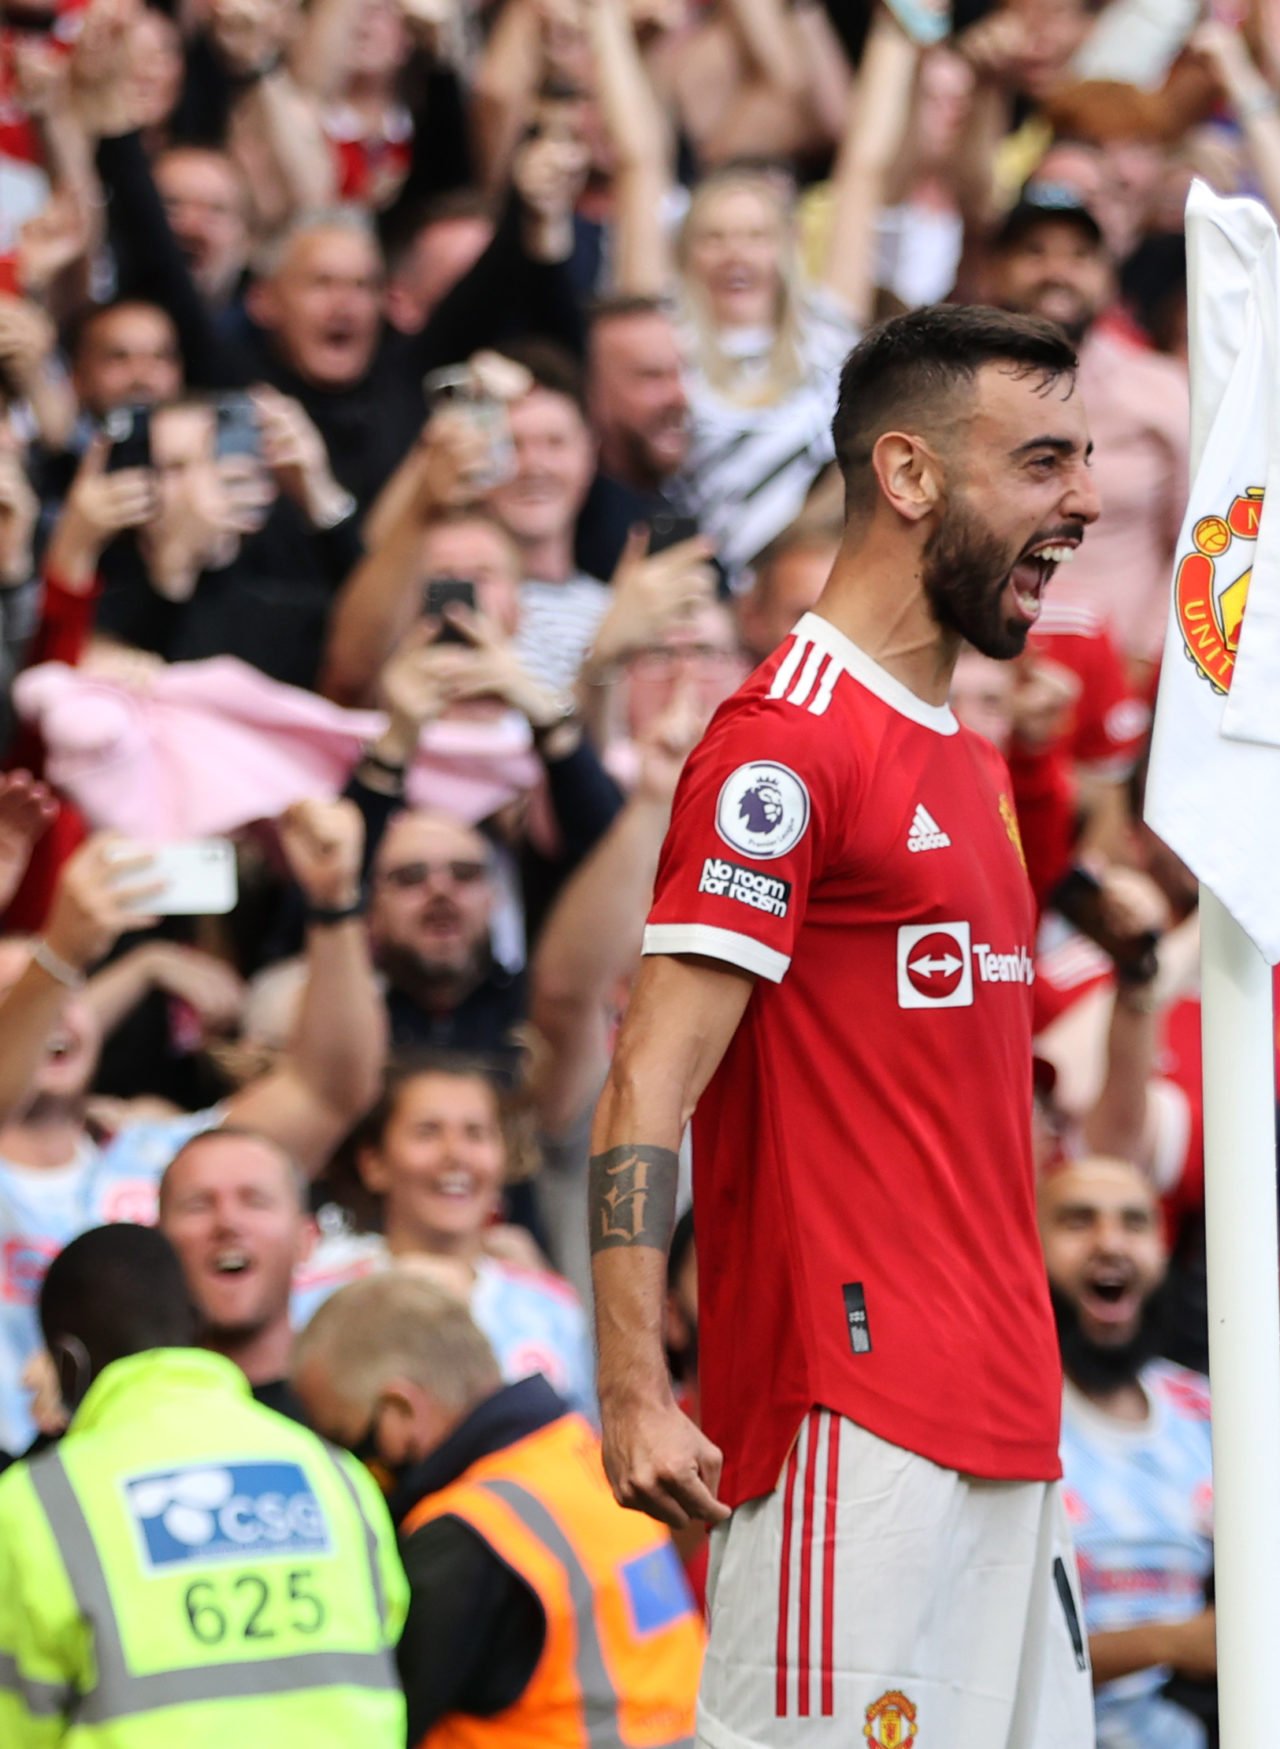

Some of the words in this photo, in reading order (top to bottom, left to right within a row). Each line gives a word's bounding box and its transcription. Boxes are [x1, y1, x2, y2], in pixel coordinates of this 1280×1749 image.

[907, 832, 951, 852] adidas
[699, 874, 730, 895] for
[729, 883, 788, 918] racism
[702, 858, 733, 880] No
[734, 867, 786, 900] room
[218, 1491, 324, 1543] CSG
[185, 1568, 325, 1645] 625
